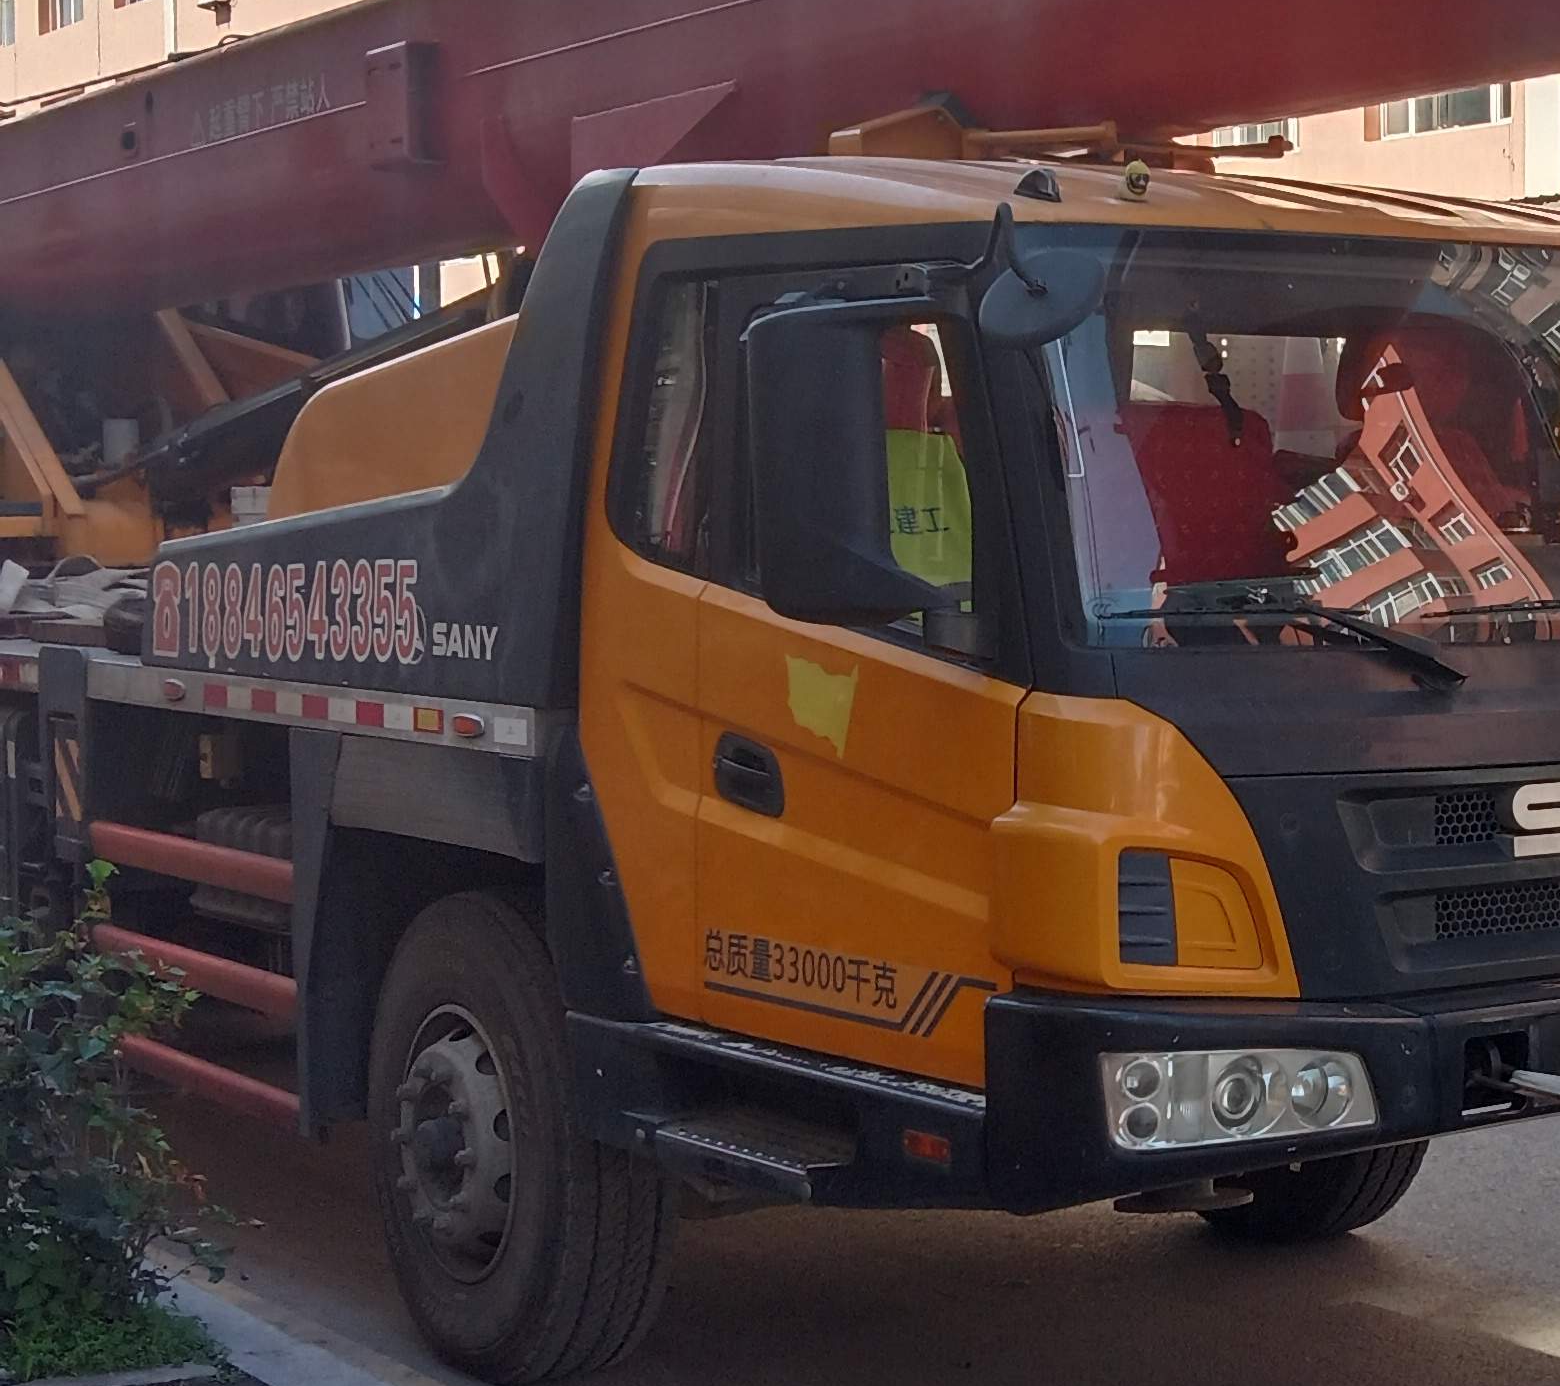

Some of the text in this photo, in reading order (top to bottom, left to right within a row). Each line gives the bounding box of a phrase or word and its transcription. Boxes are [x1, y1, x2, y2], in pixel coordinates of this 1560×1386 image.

[184, 558, 418, 664] 18846543355
[432, 622, 498, 660] SANY
[704, 929, 897, 1009] 总质量33000千克
